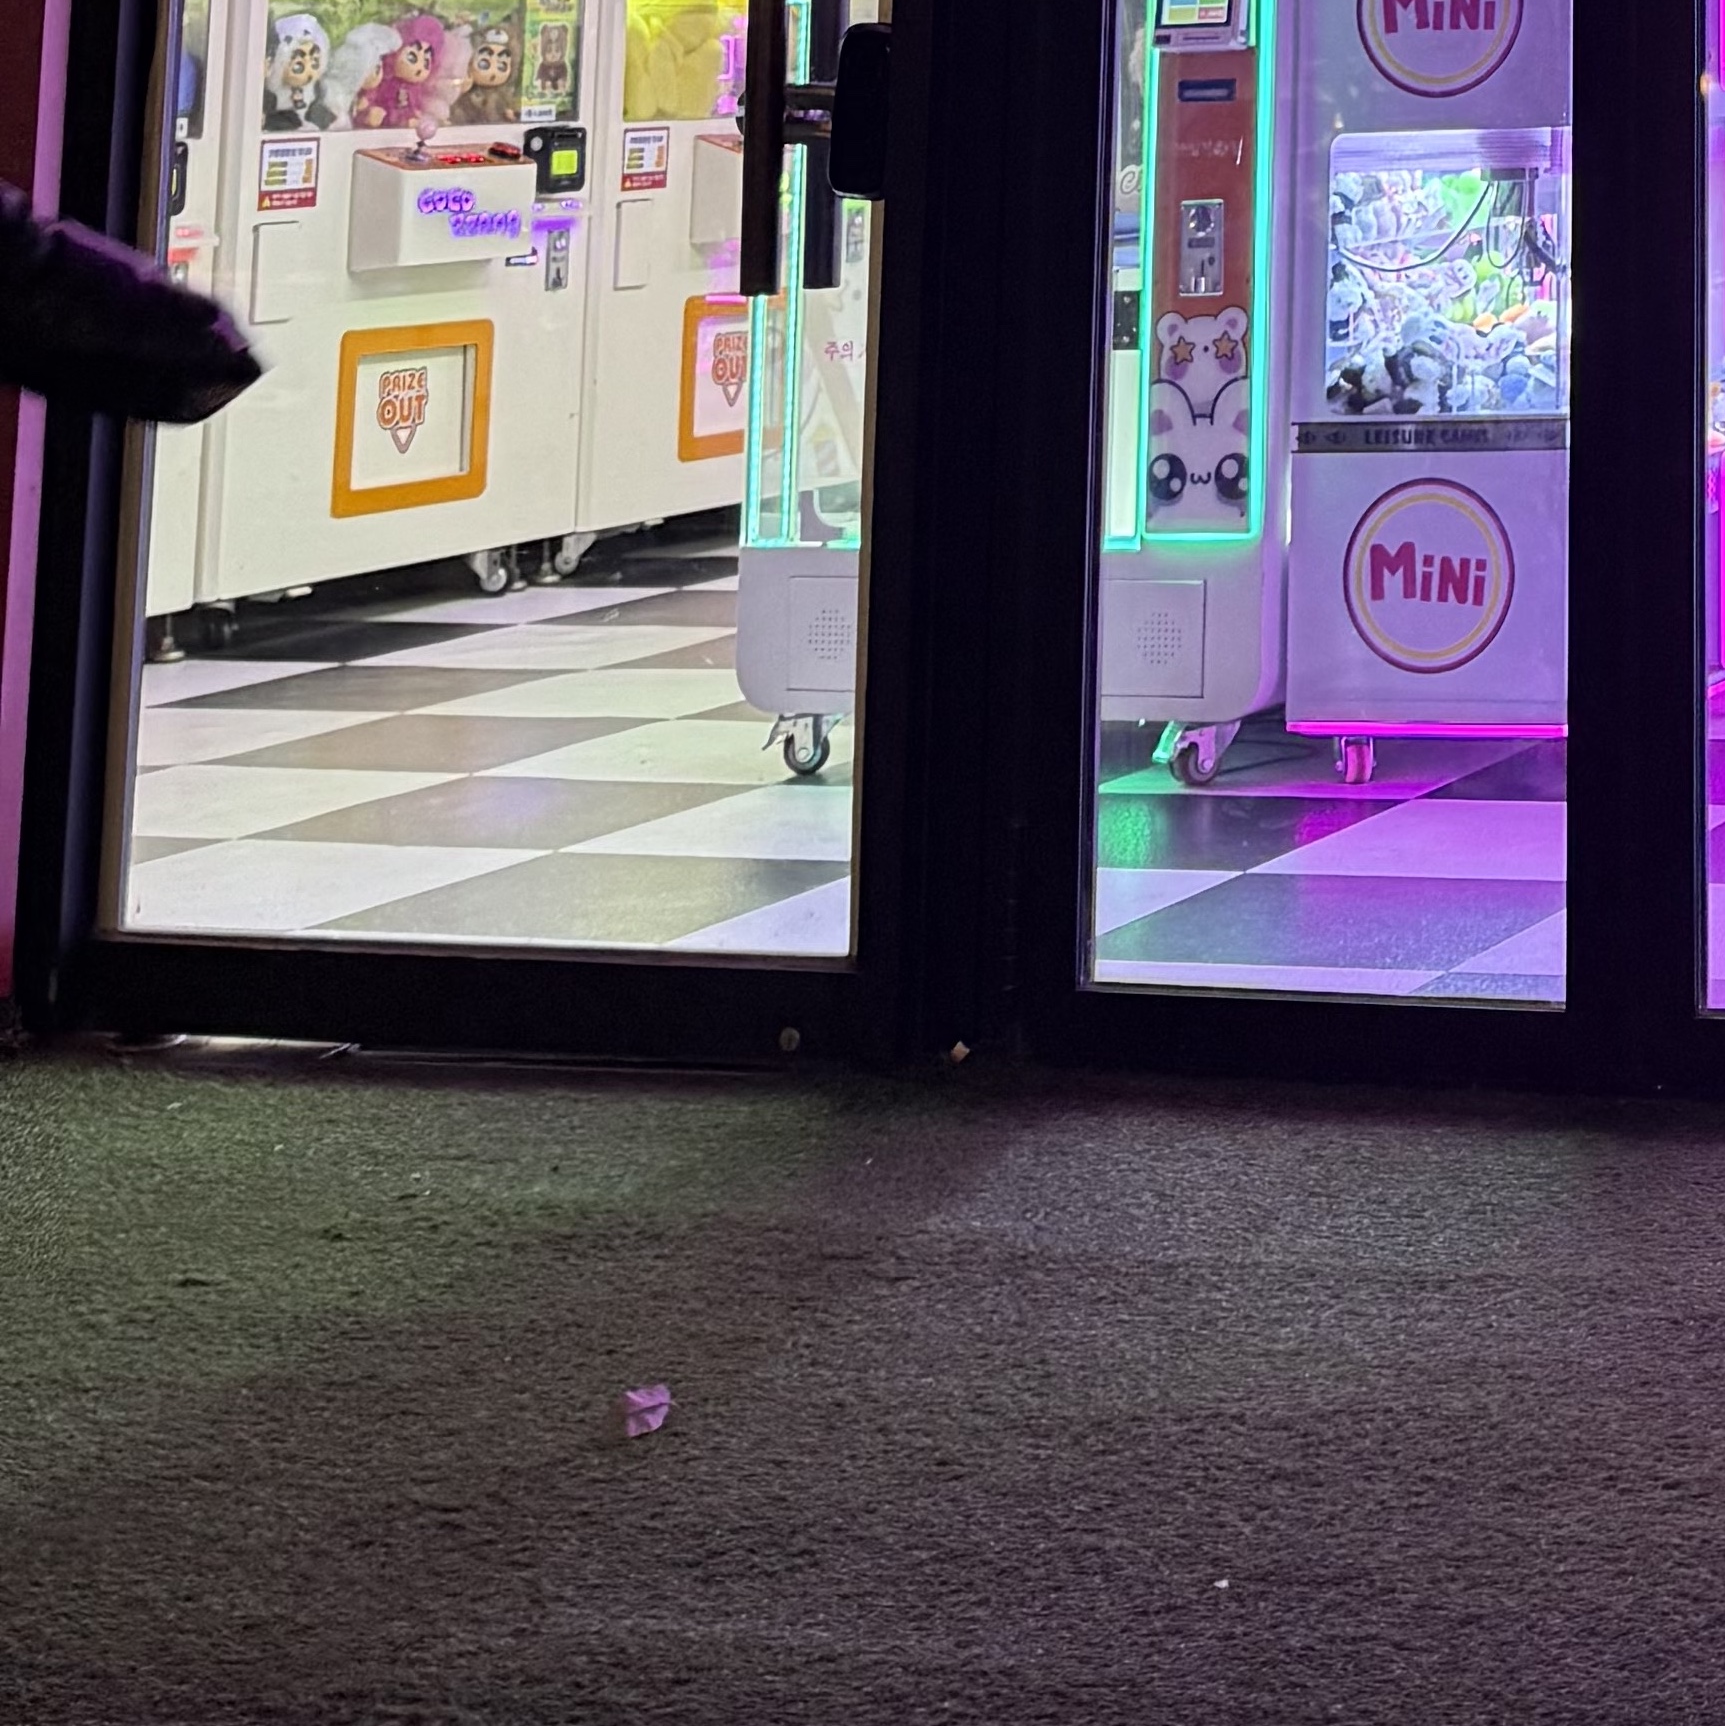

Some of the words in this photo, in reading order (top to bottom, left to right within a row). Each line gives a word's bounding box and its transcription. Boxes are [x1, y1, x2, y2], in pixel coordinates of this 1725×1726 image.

[824, 340, 854, 362] 주의
[380, 370, 427, 396] PRIZE
[378, 393, 427, 427] OUT
[1364, 428, 1436, 445] LEISURE
